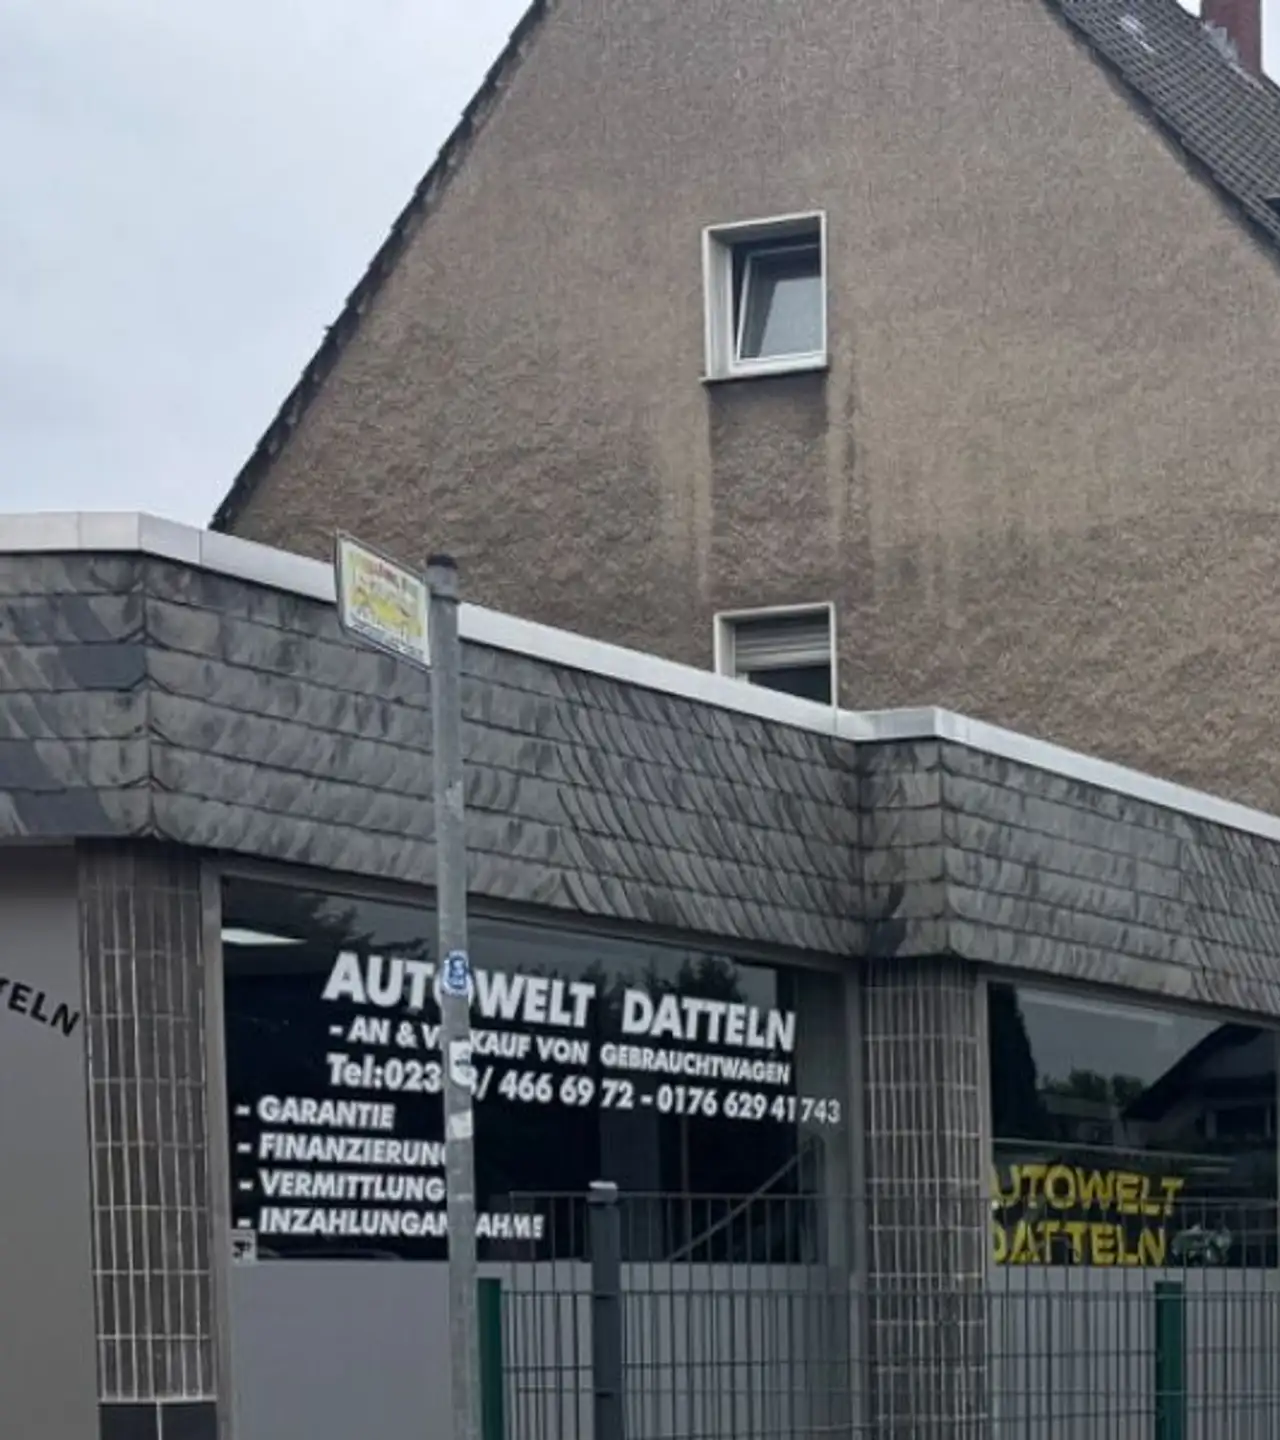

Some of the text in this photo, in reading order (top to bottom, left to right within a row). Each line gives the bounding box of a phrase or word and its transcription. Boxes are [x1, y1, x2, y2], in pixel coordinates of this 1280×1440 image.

[621, 988, 796, 1052] DATTELN
[346, 1015, 391, 1045] AN
[395, 1020, 417, 1048] &
[421, 1022, 531, 1060] VKAUF
[536, 1035, 591, 1065] VON
[600, 1042, 791, 1085] GEBRAUCHTWAGEN
[257, 1096, 396, 1130] GARANTIE
[498, 1070, 553, 1103] 466
[560, 1074, 595, 1106] 69
[600, 1078, 634, 1109] 72
[655, 1084, 718, 1116] 0176
[258, 1169, 446, 1202] VERMITTLUNG
